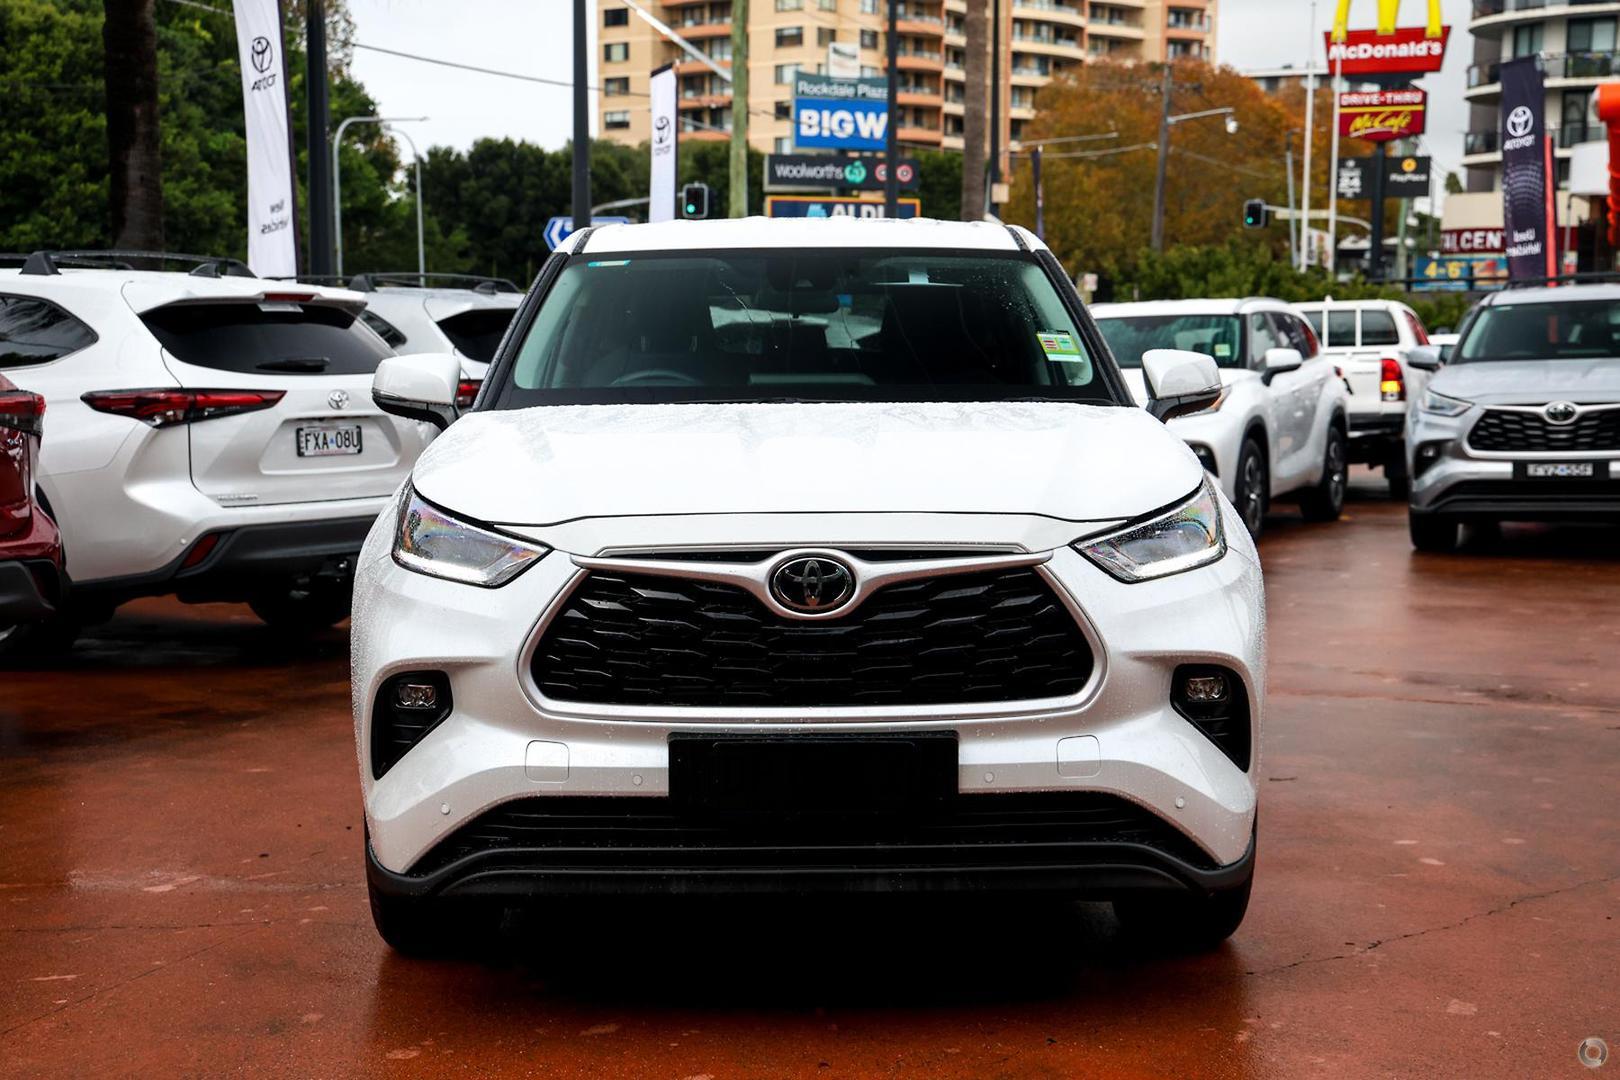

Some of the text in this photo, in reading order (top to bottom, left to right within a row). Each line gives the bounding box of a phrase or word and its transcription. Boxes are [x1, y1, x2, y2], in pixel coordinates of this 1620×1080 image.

[1329, 41, 1442, 60] McDonald's
[798, 80, 856, 97] Rockdale
[1340, 91, 1423, 106] DRIVE-THRU
[831, 203, 885, 218] ALDI
[304, 431, 330, 451] FXA
